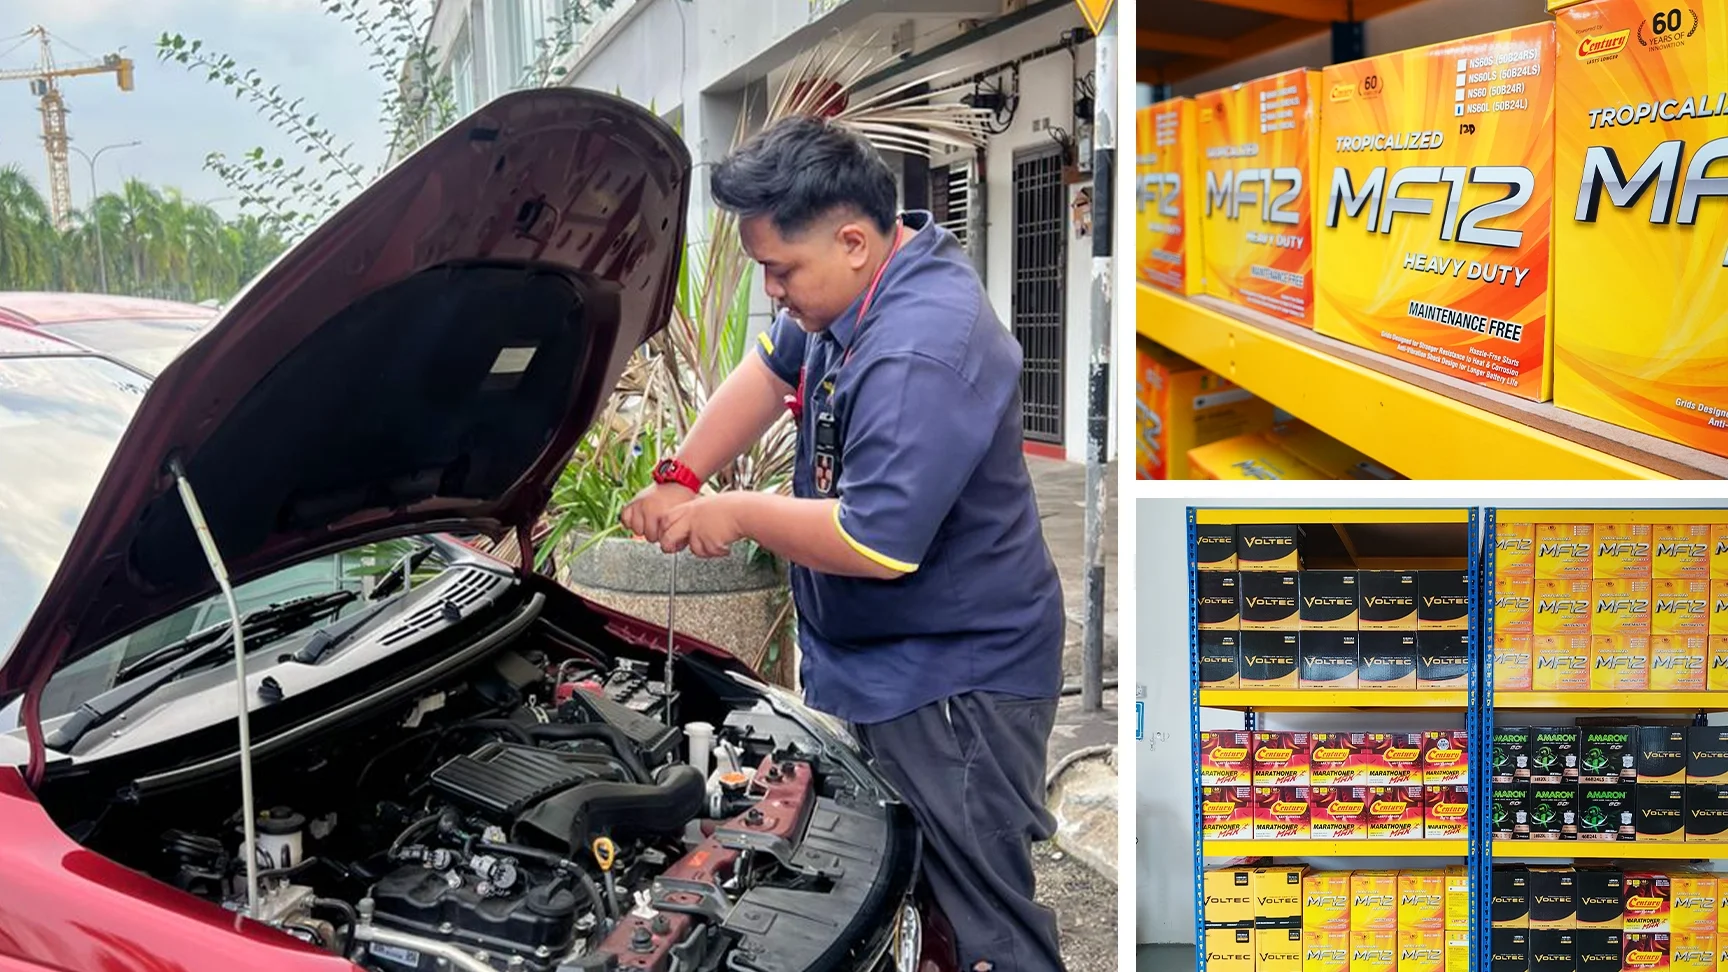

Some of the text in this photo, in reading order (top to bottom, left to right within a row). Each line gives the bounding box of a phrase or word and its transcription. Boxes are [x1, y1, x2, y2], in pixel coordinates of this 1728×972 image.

[1653, 8, 1681, 34] 60
[1649, 32, 1685, 45] YEARS OF
[1579, 34, 1626, 56] Century
[1649, 41, 1685, 52] INNOVATION
[1469, 48, 1539, 68] NS60S (50B24RS)
[1468, 64, 1541, 84] NS60LS (50B24LS)
[1364, 75, 1377, 90] 60
[1467, 82, 1525, 99] NS60 (50B24R)
[1467, 98, 1528, 114] NS60L (50B24L)
[1588, 92, 1728, 129] TROPICALI
[1336, 130, 1444, 152] TROPICALIZED
[1206, 167, 1302, 224] MF12
[1326, 166, 1535, 248] MF12
[1403, 252, 1530, 287] HEAVY DUTY
[1408, 301, 1522, 341] MAINTENANCE FREE
[1469, 346, 1519, 367] Hassle-Free Starts
[1675, 398, 1696, 410] Grids
[1197, 536, 1231, 545] VOLTEC
[1244, 536, 1292, 548] VOLTEC
[1538, 544, 1590, 557] MF12
[1598, 543, 1649, 557] MF12
[1656, 543, 1707, 557] MF12
[1197, 597, 1234, 605] VOLTEC
[1246, 596, 1295, 608] VOLTEC
[1304, 596, 1352, 608] VOLTEC
[1365, 596, 1413, 607] VOLTEC
[1423, 596, 1468, 607] VOLTEC
[1596, 600, 1649, 613] MF12
[1537, 600, 1590, 614] MF12
[1655, 600, 1707, 614] MF12
[1245, 655, 1294, 667] VOLTEC
[1304, 657, 1352, 668] VOLTEC
[1364, 656, 1411, 667] VOLTEC
[1422, 656, 1468, 667] VOLTEC
[1537, 656, 1588, 669] MF12
[1595, 655, 1647, 669] MF12
[1652, 656, 1704, 669] MF12
[1537, 734, 1576, 742] AMARON
[1588, 734, 1627, 742] AMARON
[1212, 749, 1244, 760] Century
[1257, 749, 1290, 760] Century
[1315, 749, 1347, 760] Century
[1385, 749, 1417, 760] Century
[1427, 750, 1459, 761] Century
[1643, 751, 1681, 760] VOLTEC
[1692, 751, 1728, 760] VOLTEC
[1216, 776, 1236, 784] MAX
[1275, 776, 1297, 784] MAX
[1333, 776, 1354, 784] MAX
[1389, 776, 1410, 784] MAX
[1441, 774, 1459, 782] MAX
[1272, 803, 1305, 814] Century
[1330, 803, 1362, 813] Century
[1372, 803, 1404, 813] Century
[1434, 804, 1466, 814] Century
[1642, 809, 1680, 818] VOLTEC
[1691, 809, 1728, 818] VOLTEC
[1218, 830, 1239, 838] MAX
[1276, 830, 1297, 838] MAX
[1333, 829, 1354, 837] MAX
[1390, 829, 1411, 837] MAX
[1257, 897, 1298, 906] VOLTEC
[1306, 896, 1346, 907] MF12
[1354, 895, 1394, 906] MF12
[1401, 895, 1441, 905] MF12
[1535, 896, 1571, 904] VOLTEC
[1582, 897, 1619, 905] VOLTEC
[1628, 898, 1661, 908] Century
[1674, 898, 1715, 908] MF12
[1260, 952, 1299, 961] VOLTEC
[1306, 950, 1346, 960] MF12
[1354, 950, 1393, 960] MF12
[1401, 950, 1441, 960] MF12
[1535, 954, 1571, 963] VOLTEC
[1582, 955, 1618, 963] VOLTEC
[1628, 952, 1659, 962] Century
[1674, 951, 1714, 962] MF12
